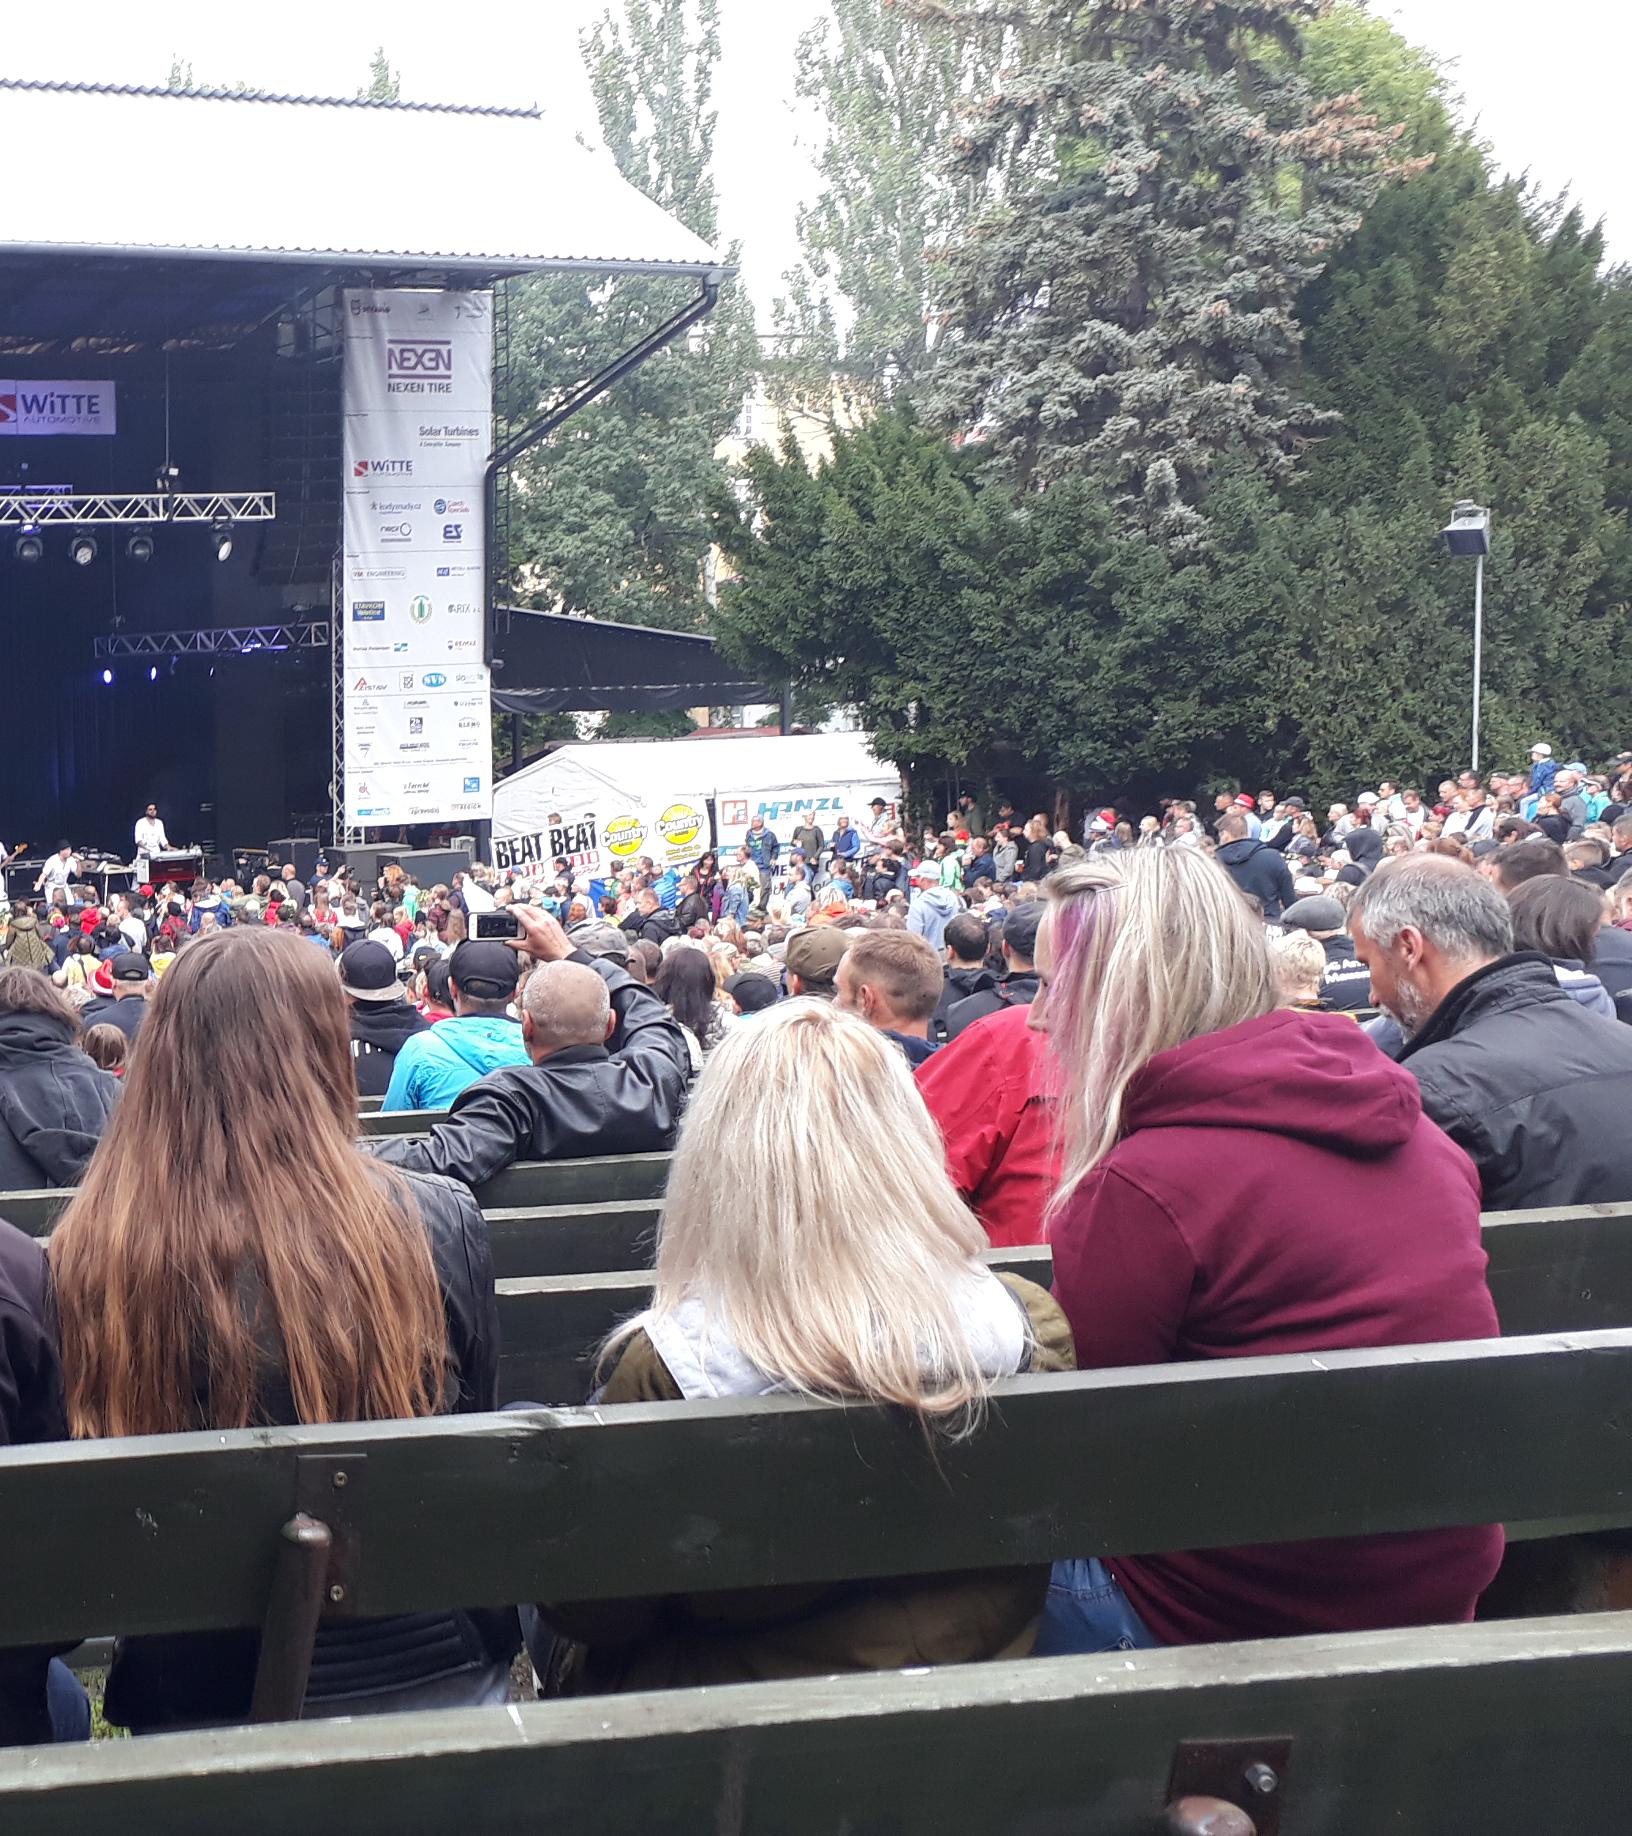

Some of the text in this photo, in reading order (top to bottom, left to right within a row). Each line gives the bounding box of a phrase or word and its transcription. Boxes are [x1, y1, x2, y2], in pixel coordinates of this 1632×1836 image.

[387, 348, 452, 370] NEXEN
[387, 382, 452, 393] NEXEN TIRE
[419, 426, 479, 436] Solar Turbines
[600, 825, 649, 847] Country
[655, 814, 705, 836] Country
[494, 831, 543, 870] BEAT
[549, 820, 598, 858] BEAT
